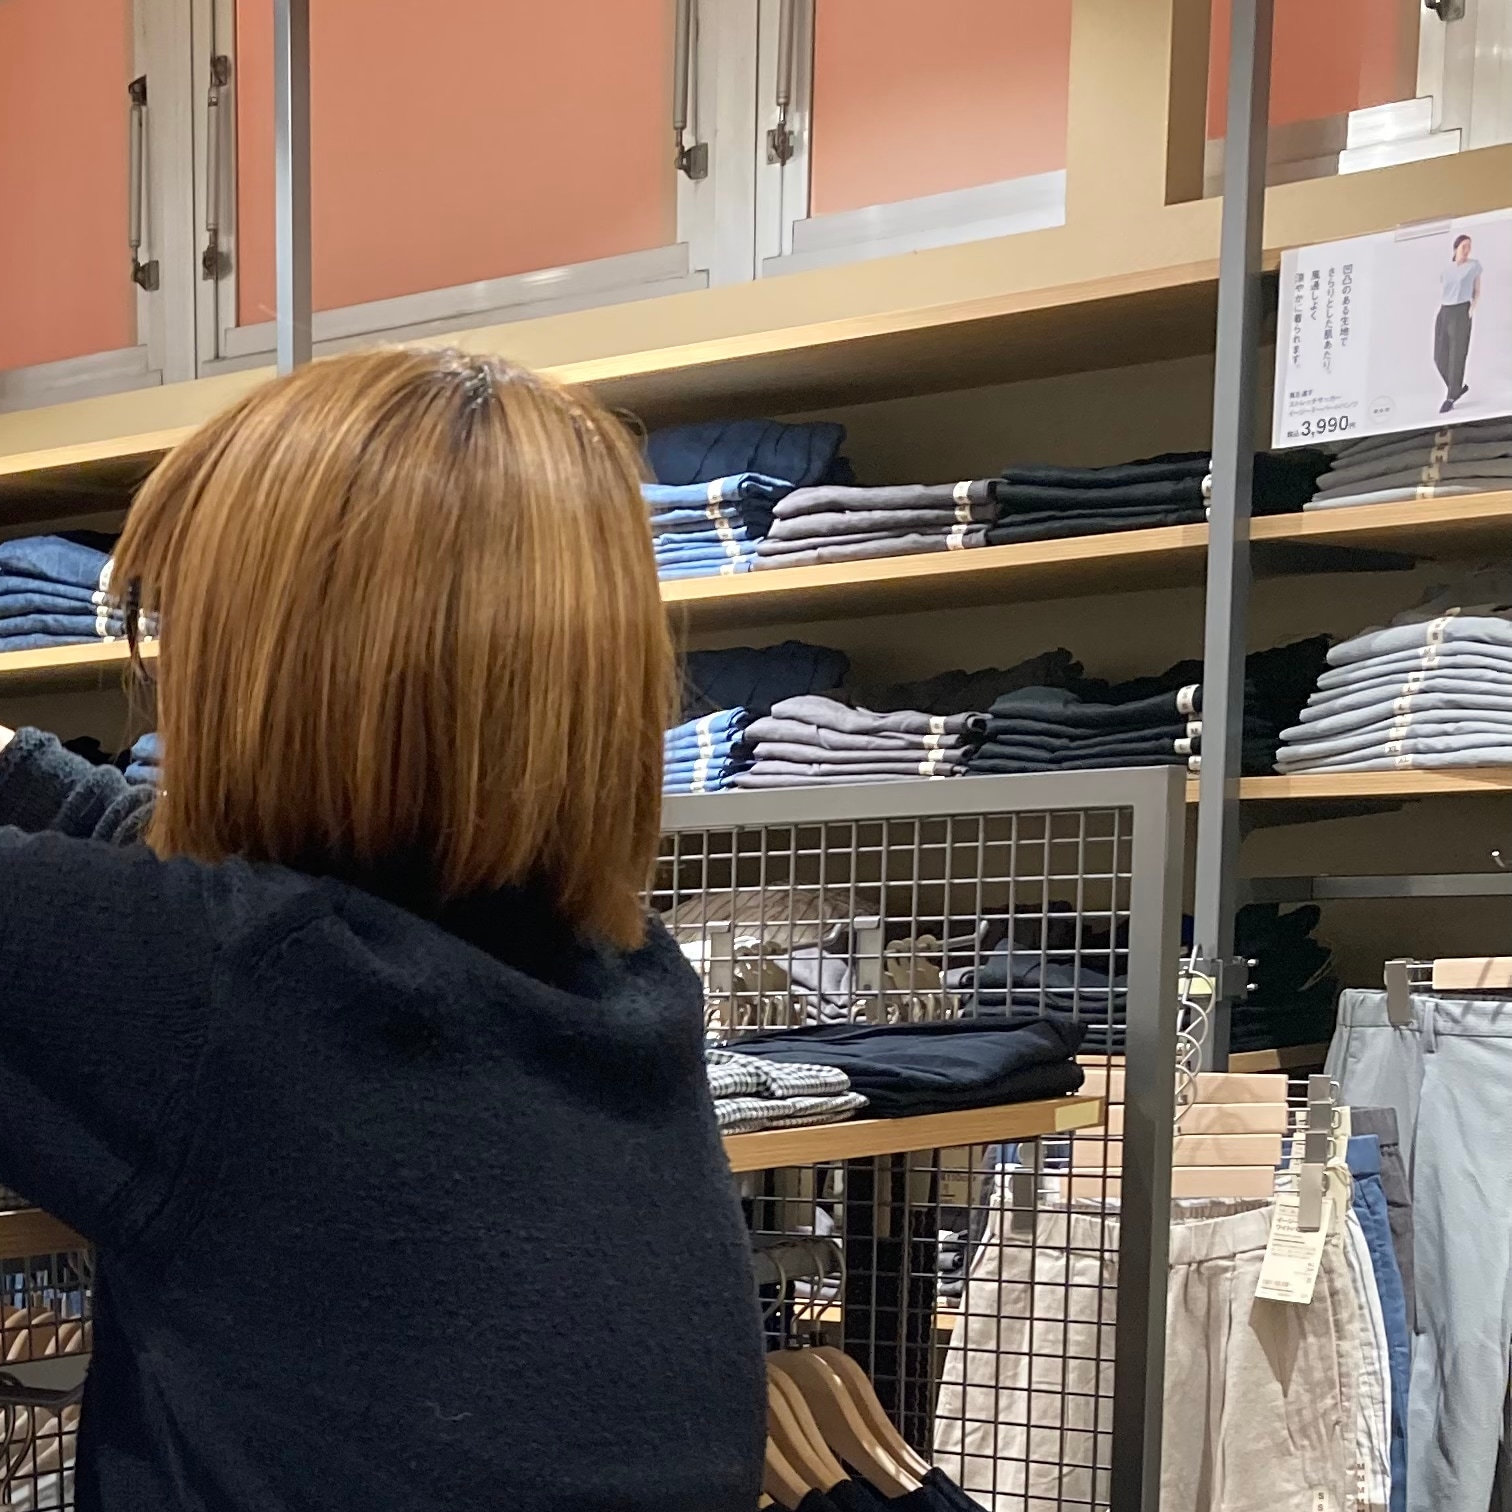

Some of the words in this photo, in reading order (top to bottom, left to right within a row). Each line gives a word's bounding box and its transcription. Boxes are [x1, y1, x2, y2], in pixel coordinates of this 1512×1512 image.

[1309, 269, 1321, 321] 風通しよく
[1340, 263, 1354, 348] 凹凸のある生地で
